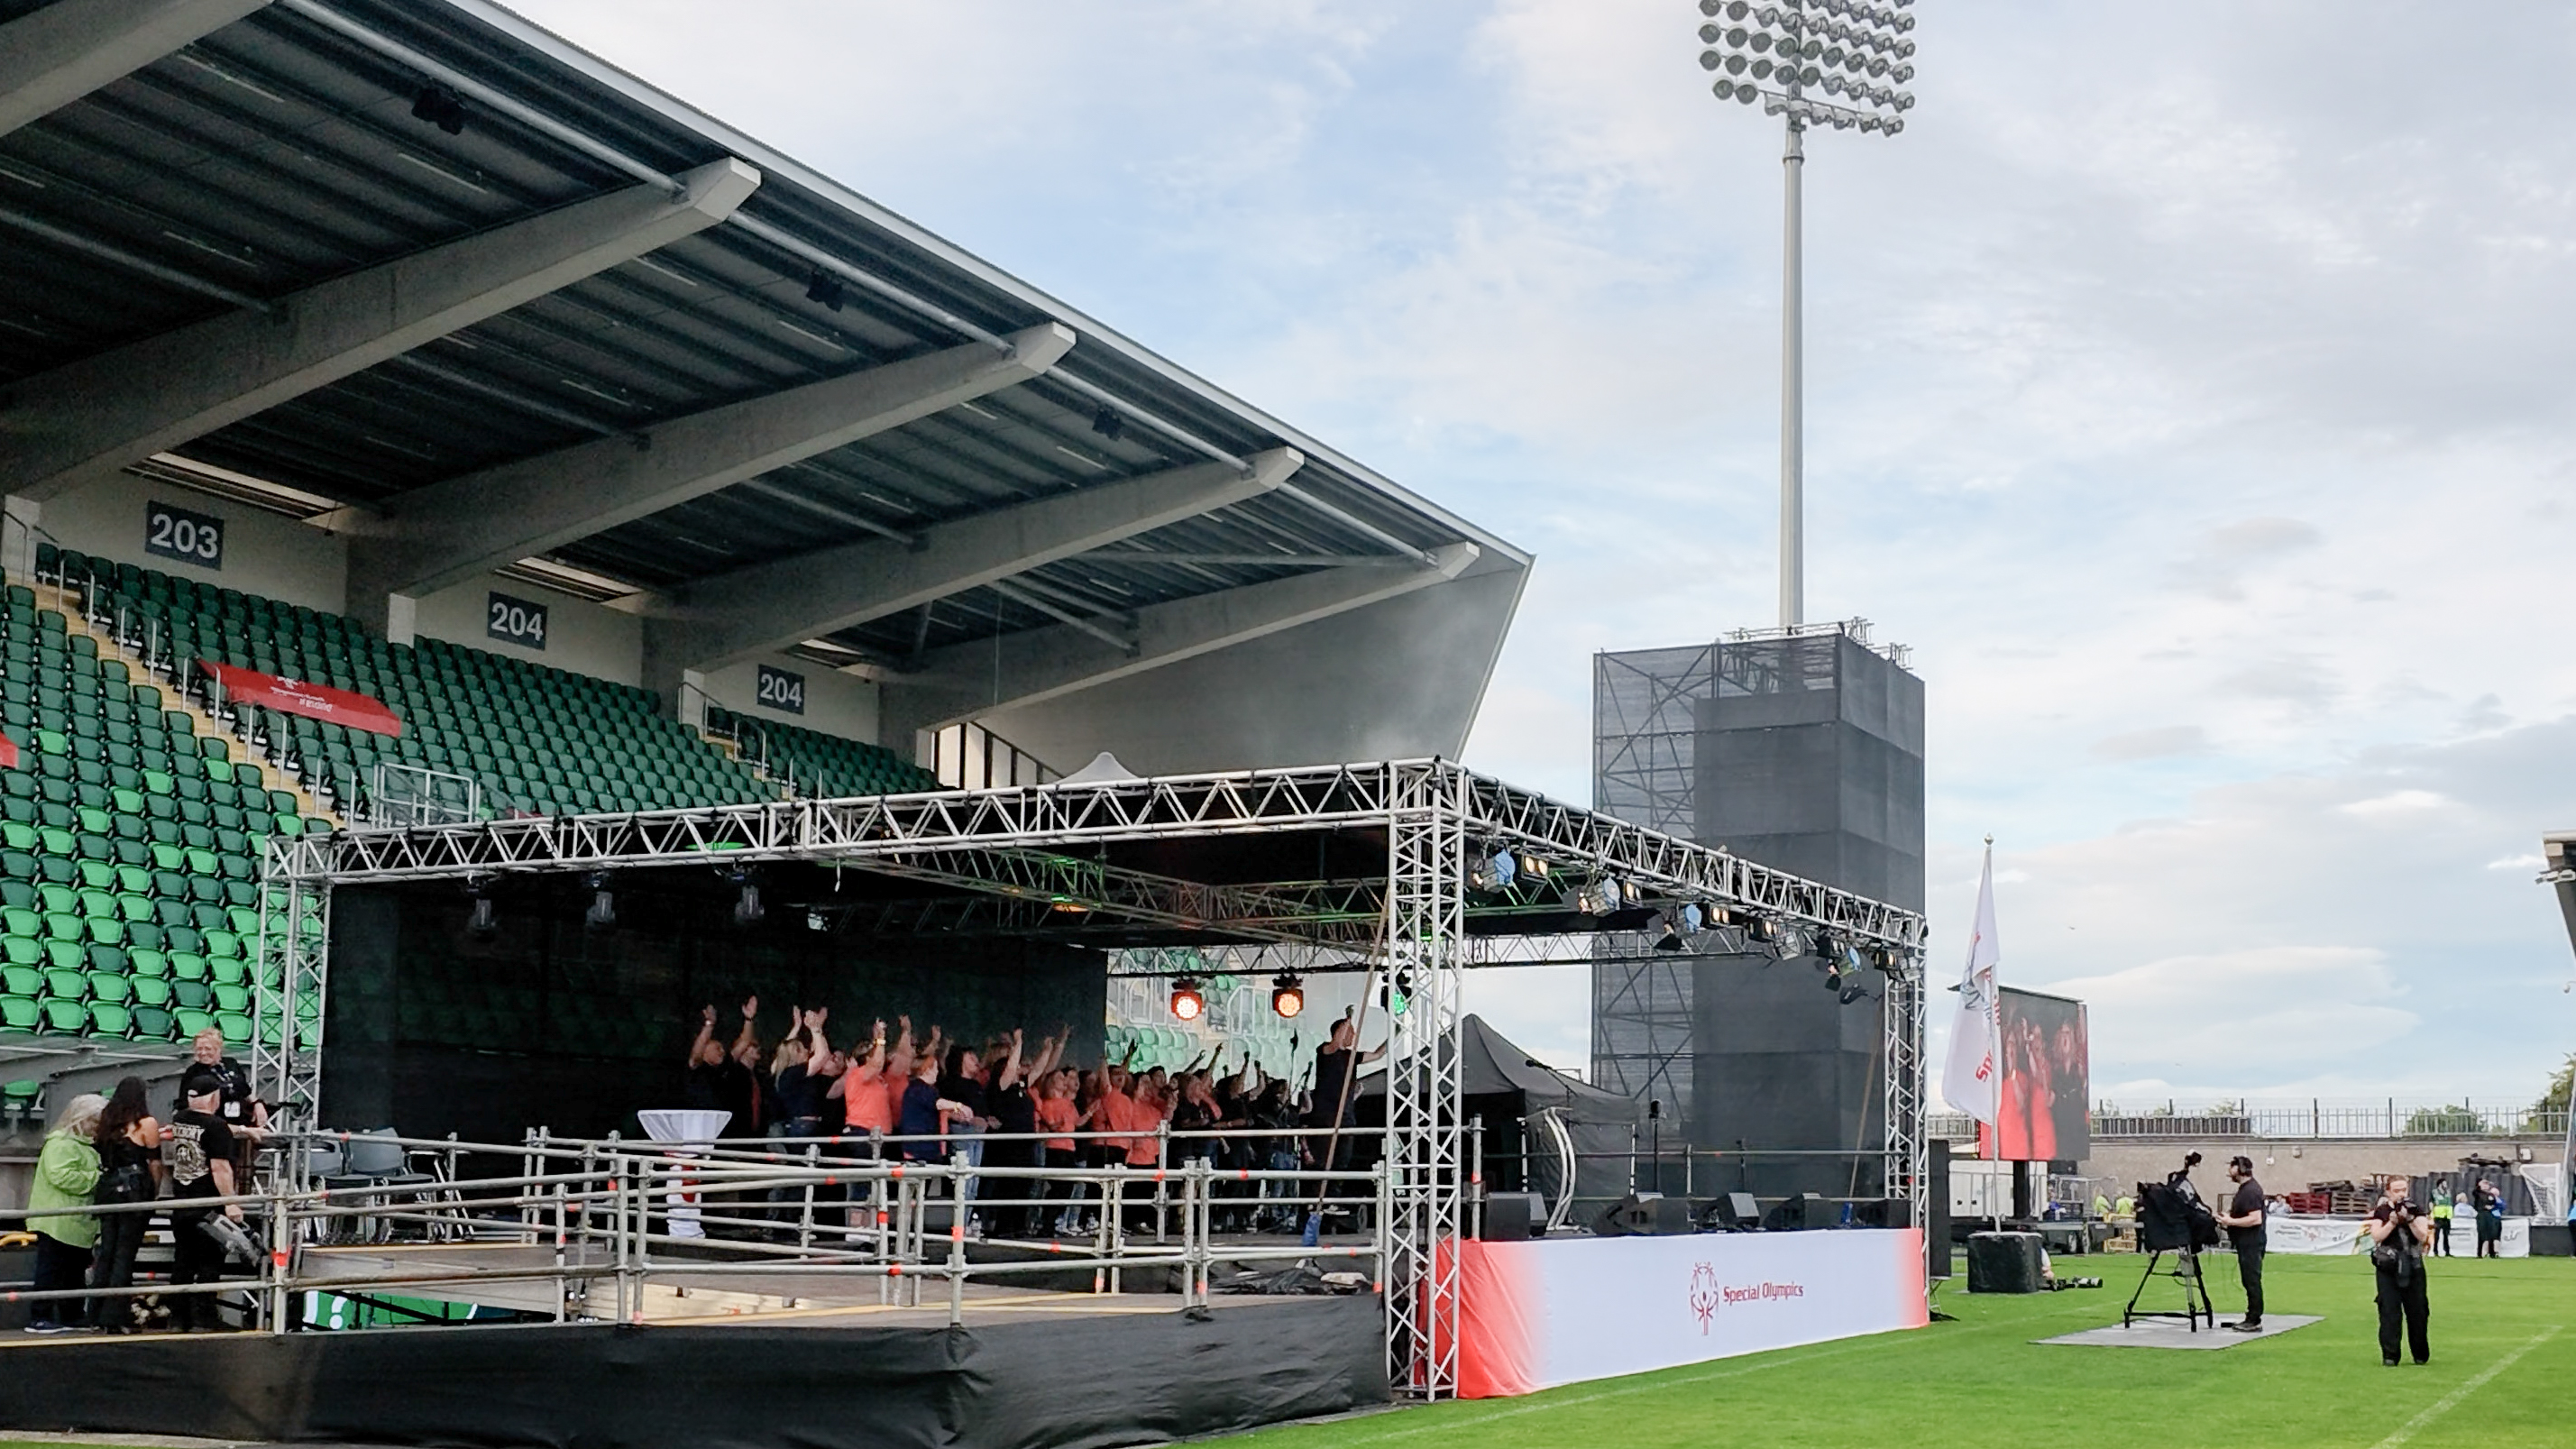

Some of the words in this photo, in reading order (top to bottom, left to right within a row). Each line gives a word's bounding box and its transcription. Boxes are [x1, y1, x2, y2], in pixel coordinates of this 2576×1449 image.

[151, 513, 218, 559] 203
[491, 601, 544, 642] 204
[760, 673, 802, 708] 204
[1723, 1285, 1759, 1306] Special
[1763, 1281, 1803, 1300] Olympics
